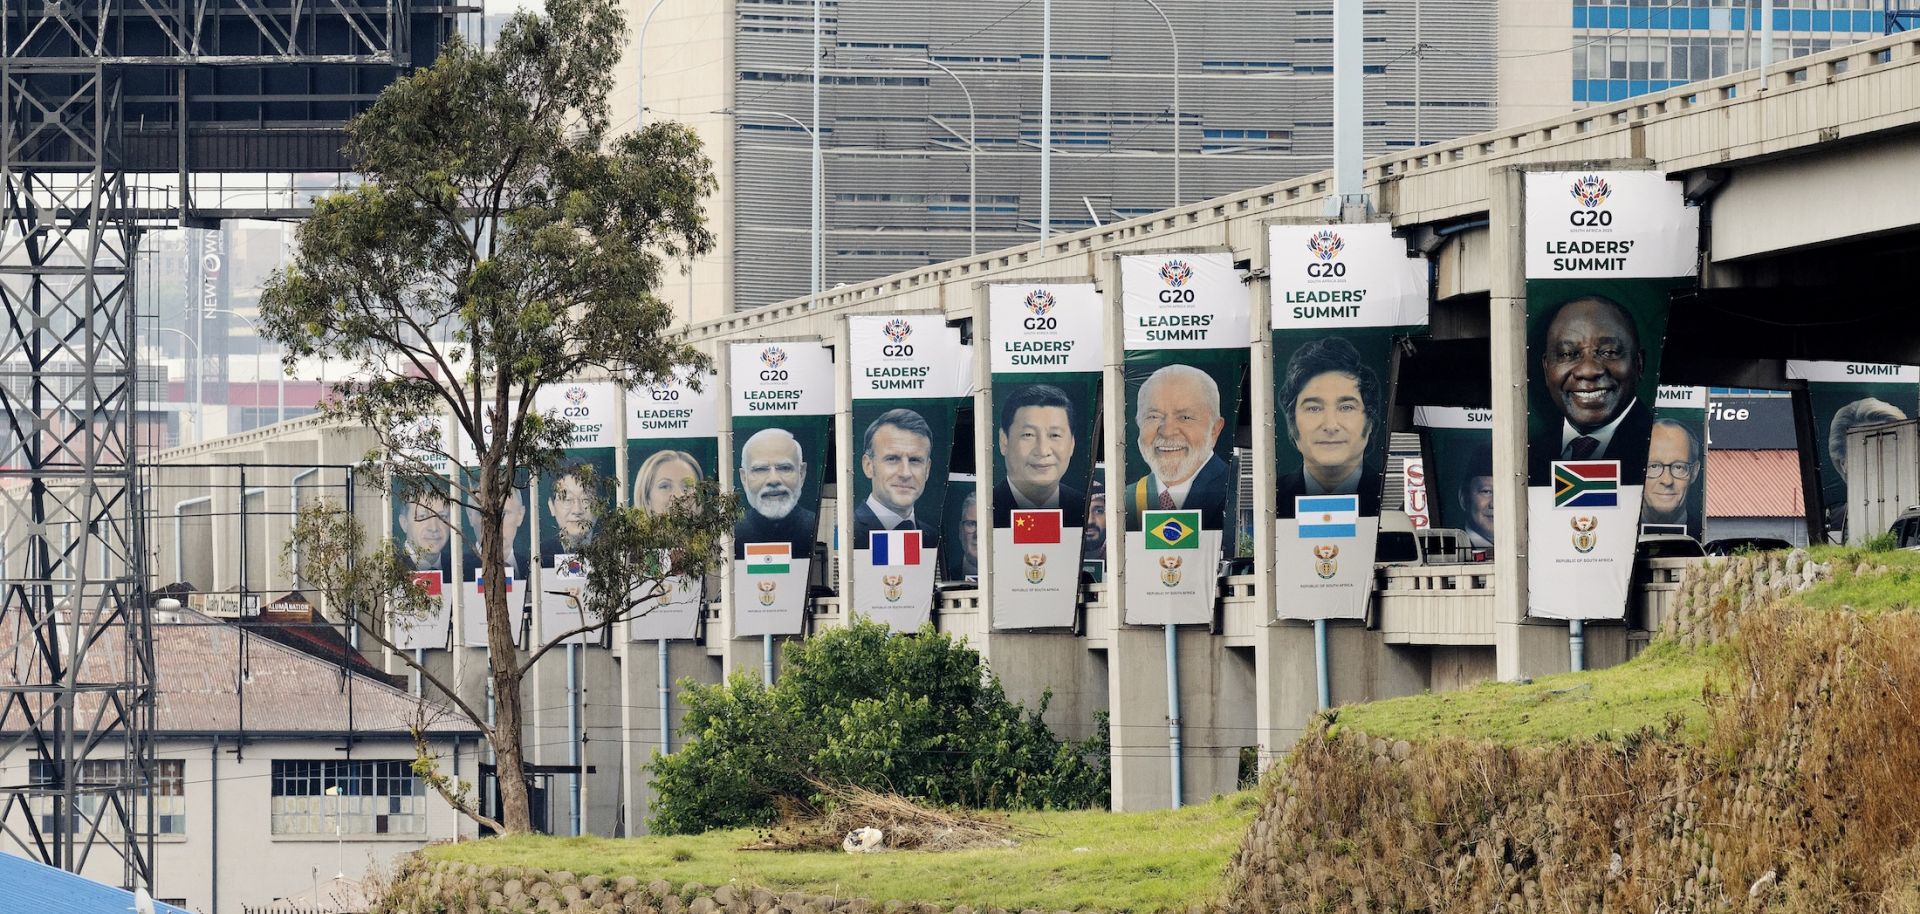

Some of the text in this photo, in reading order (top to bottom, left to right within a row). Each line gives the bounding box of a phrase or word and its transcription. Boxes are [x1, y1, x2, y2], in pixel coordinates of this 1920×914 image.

[1570, 210, 1613, 226] G20
[1546, 240, 1635, 254] LEADERS'
[1307, 262, 1346, 278] G20
[1553, 257, 1627, 271] SUMMIT
[204, 230, 220, 319] NEWTOWN
[1159, 289, 1195, 303] G20
[1286, 289, 1367, 303] LEADERS'
[1293, 305, 1361, 319] SUMMIT
[1024, 317, 1057, 330] G20
[1139, 314, 1214, 327] LEADERS'
[1146, 329, 1208, 341] SUMMIT
[883, 345, 914, 357] G20
[1005, 341, 1075, 352] LEADERS'
[1011, 354, 1069, 365] SUMMIT
[760, 370, 788, 381] G20
[866, 366, 930, 377] LEADERS'
[1846, 364, 1902, 376] SUMMIT
[872, 379, 925, 389] SUMMIT
[652, 390, 679, 401] G20
[744, 389, 803, 399] LEADERS'
[1658, 390, 1693, 399] MMIT
[564, 407, 589, 417] G20
[749, 401, 798, 411] SUMMIT
[1707, 402, 1749, 421] fice
[637, 409, 693, 419] LEADERS'
[1467, 412, 1492, 422] SUM
[642, 420, 689, 430] SUMMIT
